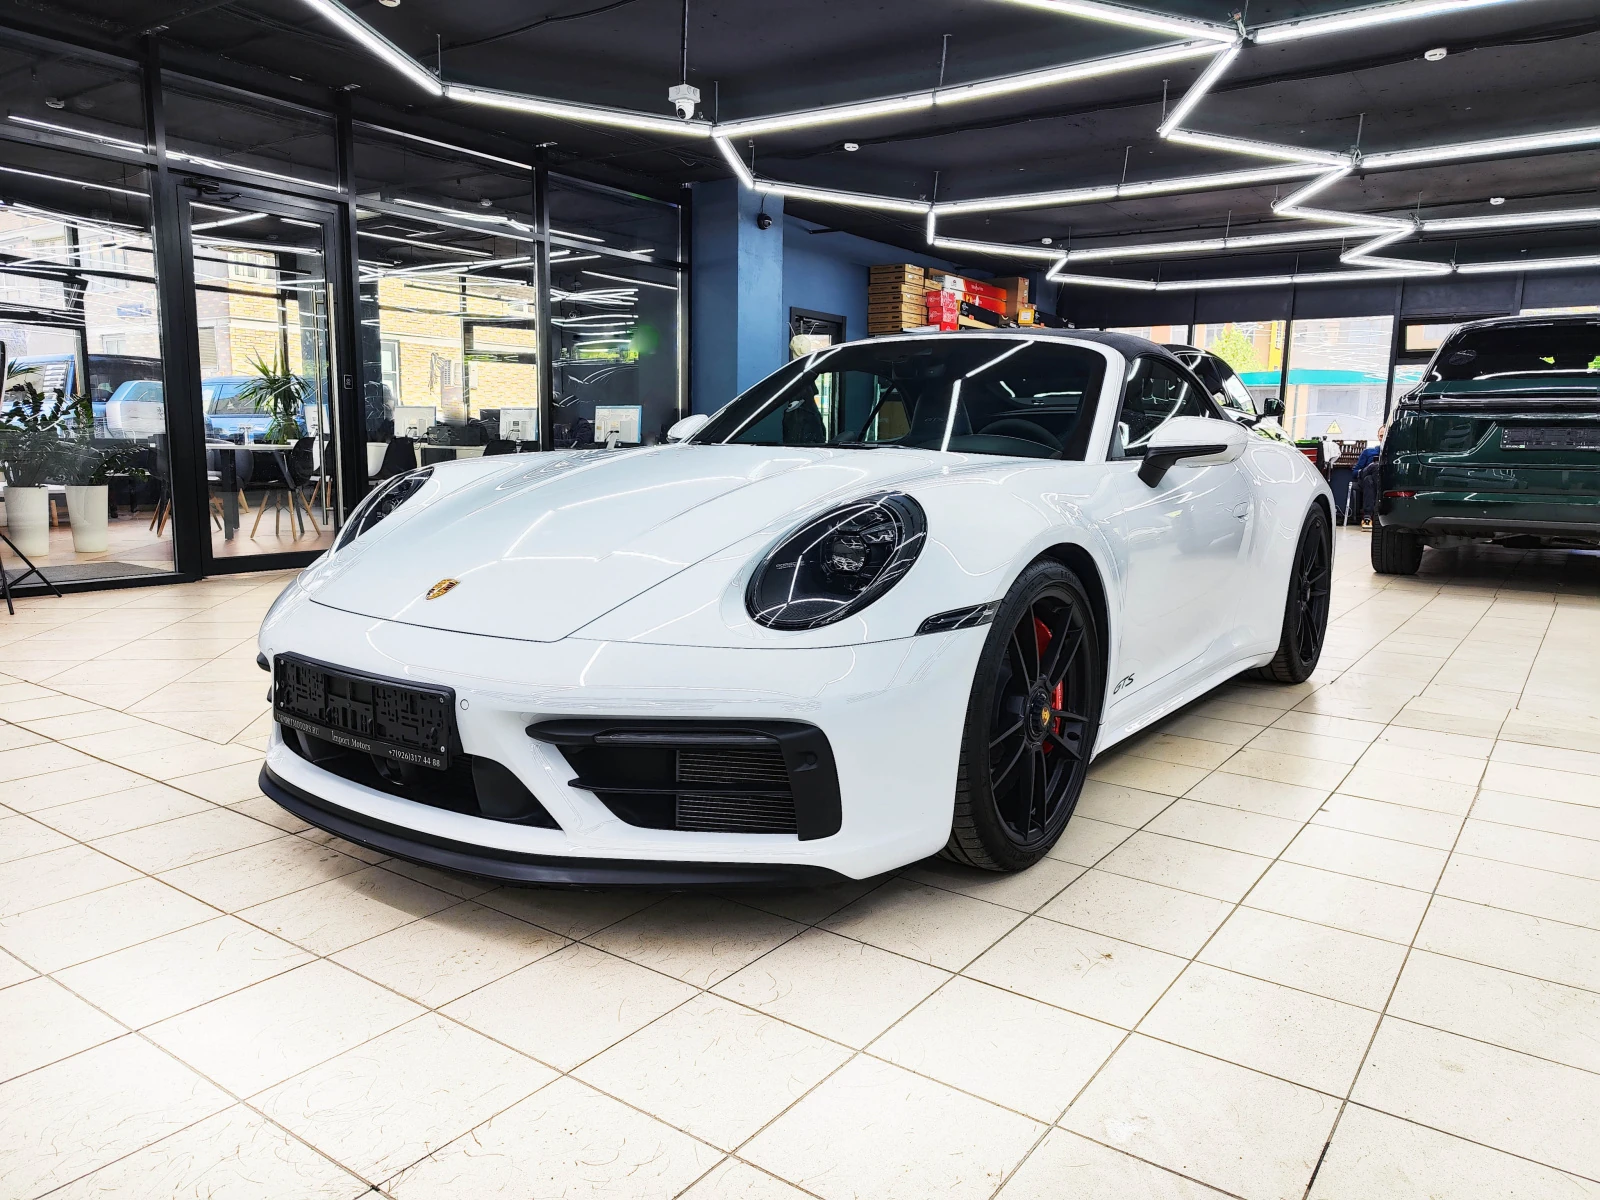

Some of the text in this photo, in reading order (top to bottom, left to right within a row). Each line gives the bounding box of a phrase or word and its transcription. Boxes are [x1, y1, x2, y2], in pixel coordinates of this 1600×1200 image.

[1113, 672, 1136, 695] GTS
[331, 730, 371, 751] Import Motors
[423, 756, 431, 765] 44
